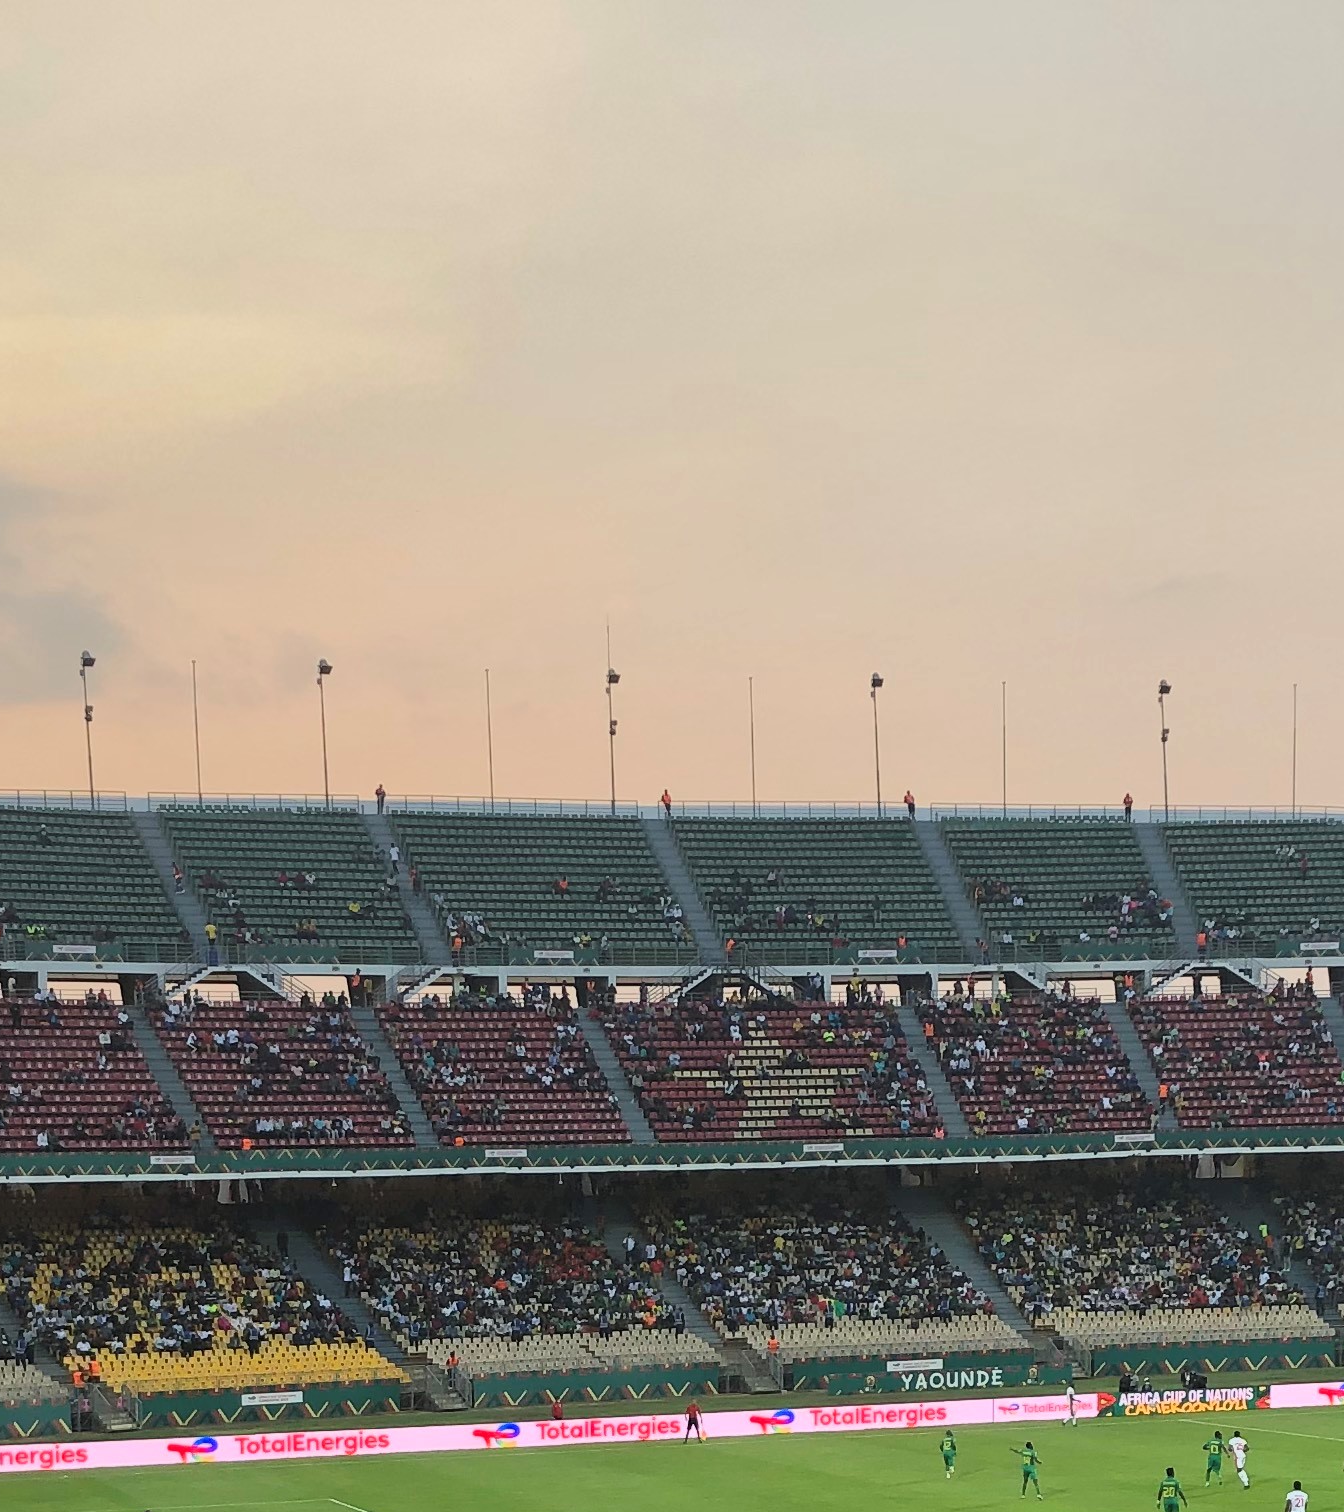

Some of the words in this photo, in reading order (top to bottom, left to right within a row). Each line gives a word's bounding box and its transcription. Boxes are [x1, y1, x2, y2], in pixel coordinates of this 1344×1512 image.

[1119, 1392, 1160, 1406] AFRICA
[1163, 1391, 1187, 1404] CUP
[1189, 1389, 1203, 1402] OF
[1206, 1387, 1254, 1402] NATIONS
[810, 1404, 947, 1428] TotalEnergies
[537, 1417, 681, 1442] TotalEnergies
[235, 1430, 390, 1456] TotalEnergies
[1163, 1486, 1175, 1498] 20
